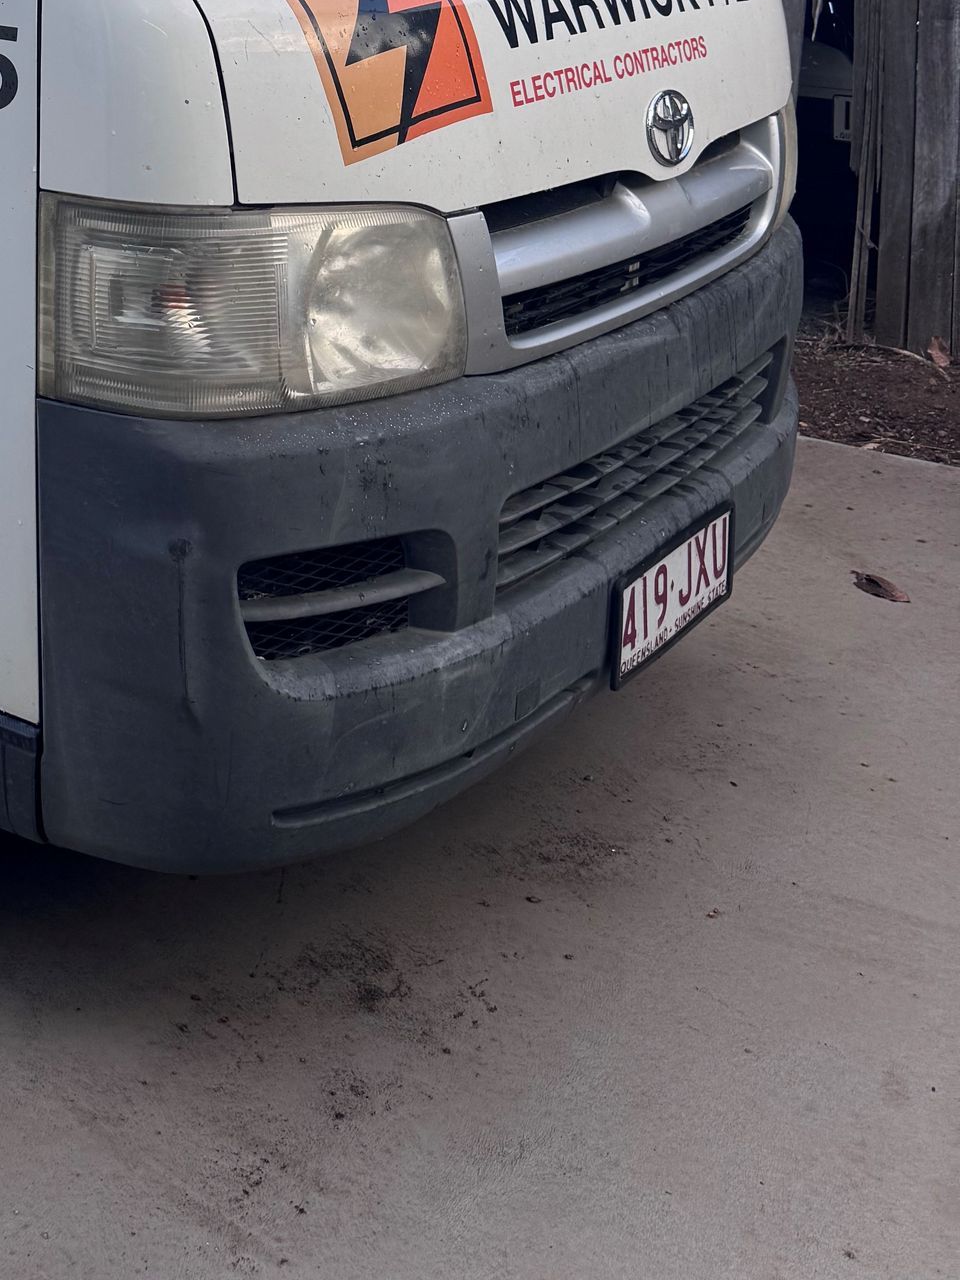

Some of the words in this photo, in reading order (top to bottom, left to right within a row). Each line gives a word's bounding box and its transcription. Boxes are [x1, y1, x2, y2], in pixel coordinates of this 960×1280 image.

[510, 59, 611, 108] ELECTRICAL
[613, 36, 708, 80] CONTRACTORS
[620, 625, 669, 674] QUEENSLAND
[674, 596, 705, 632] SUNSHINE
[707, 579, 727, 604] STATE
